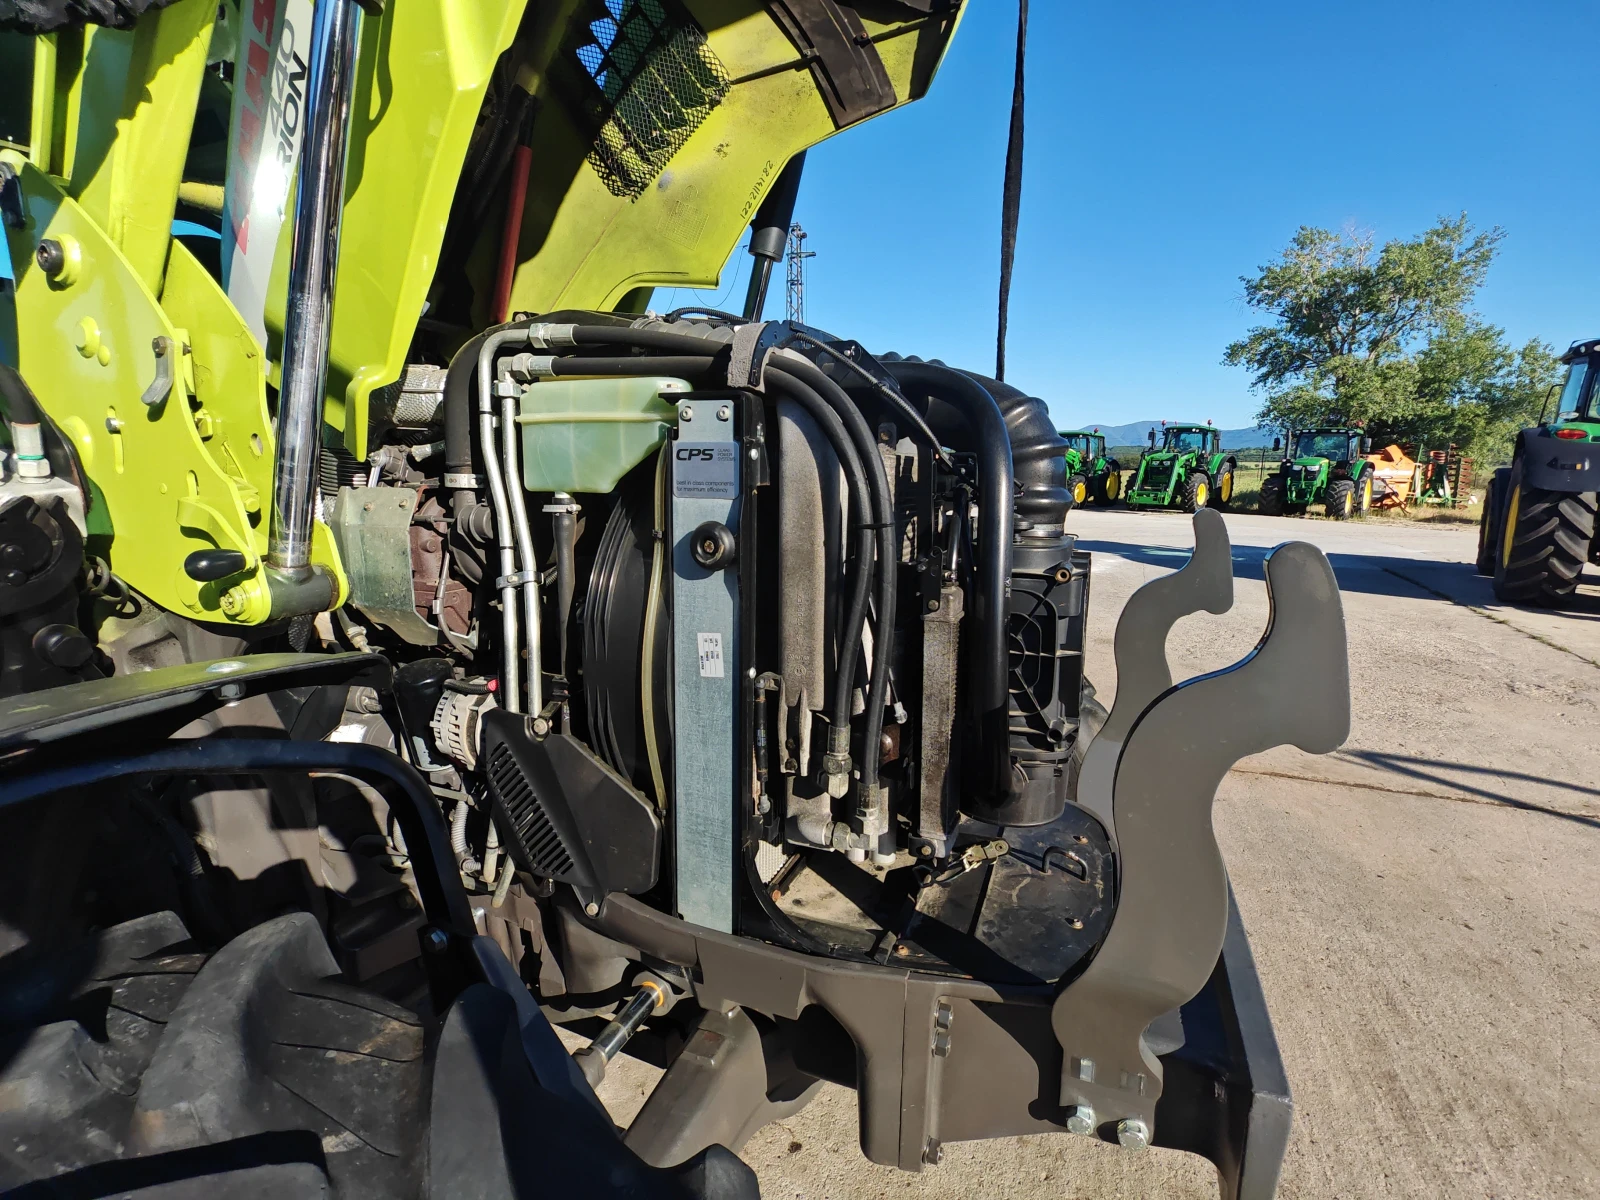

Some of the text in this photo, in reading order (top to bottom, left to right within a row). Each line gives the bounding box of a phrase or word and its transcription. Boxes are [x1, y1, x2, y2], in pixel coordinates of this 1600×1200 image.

[270, 18, 295, 138] 440
[275, 50, 308, 222] RION
[676, 448, 714, 461] CPS
